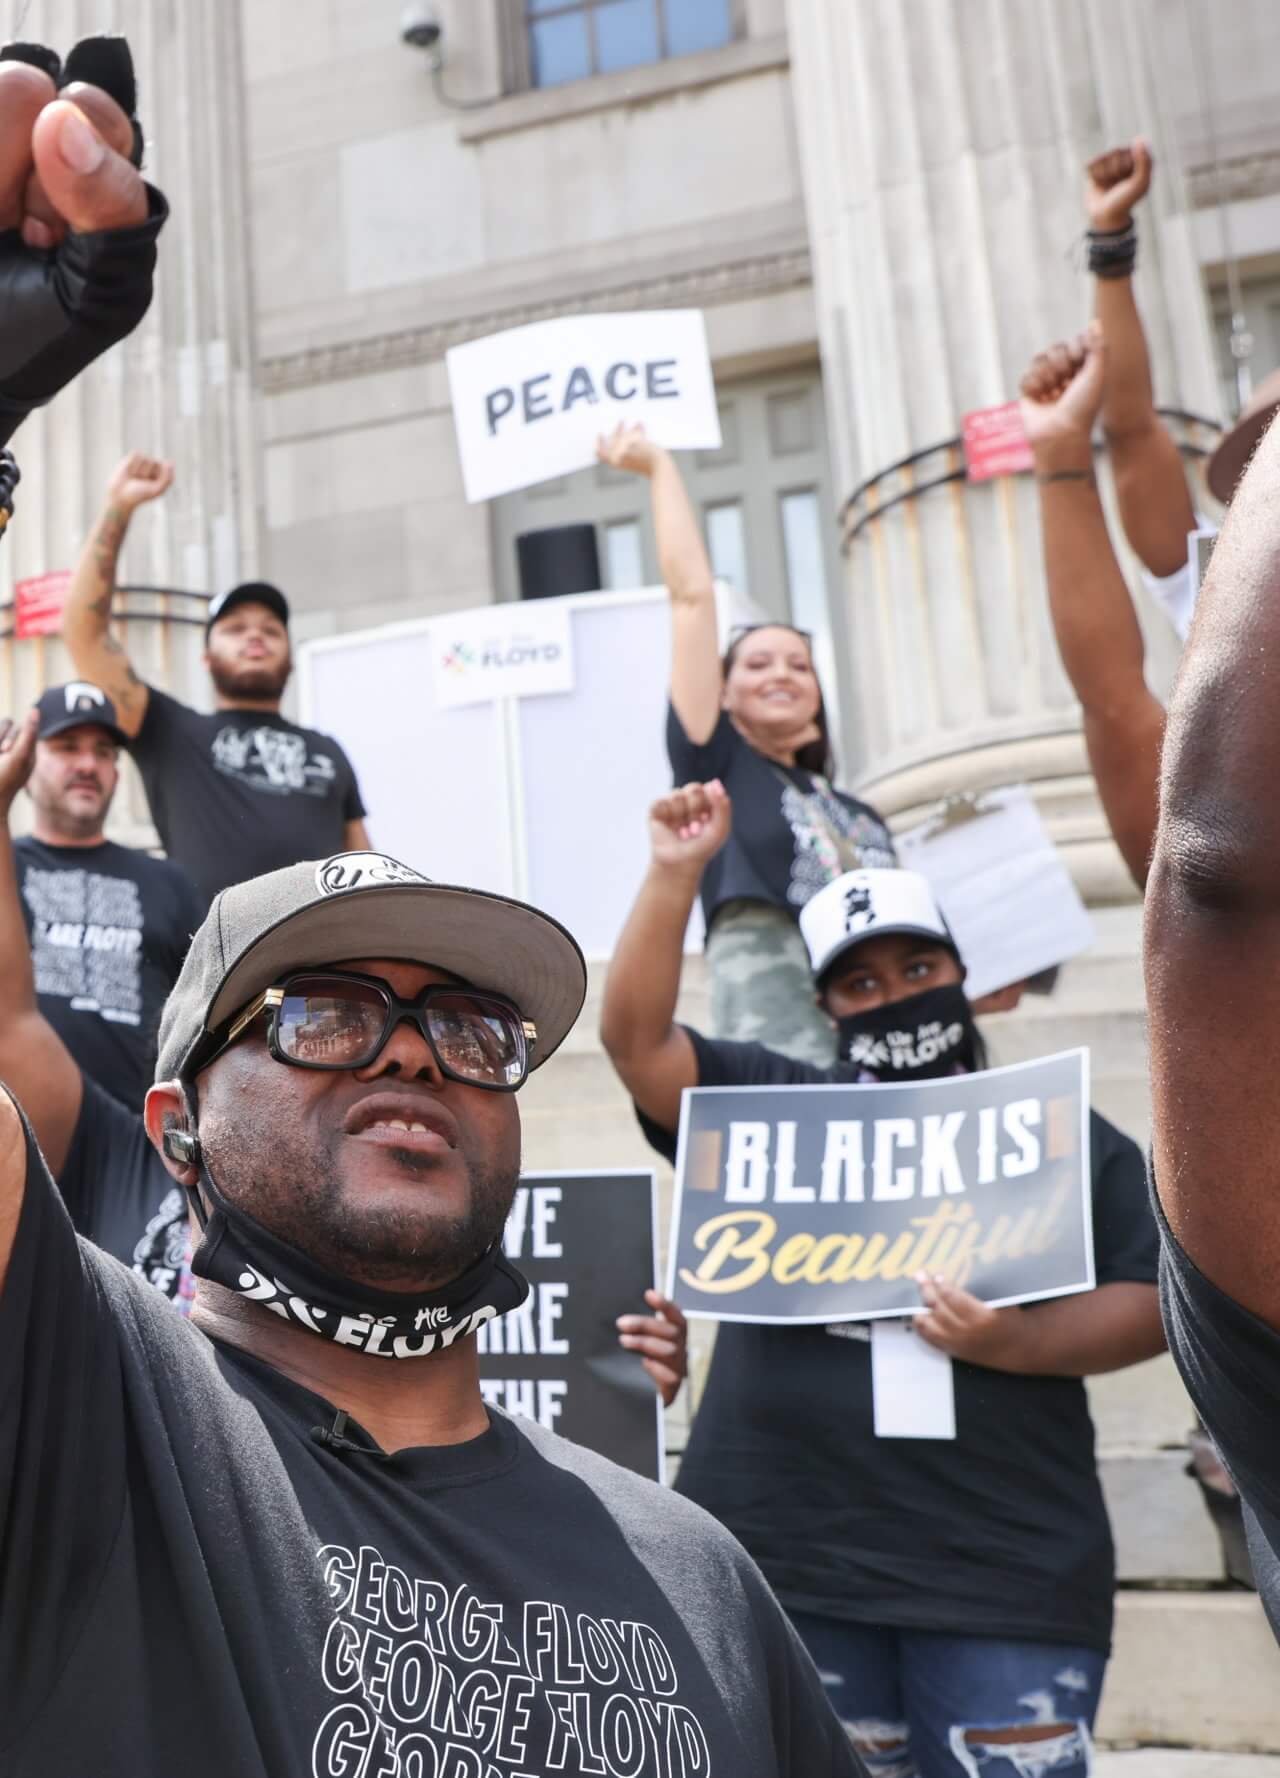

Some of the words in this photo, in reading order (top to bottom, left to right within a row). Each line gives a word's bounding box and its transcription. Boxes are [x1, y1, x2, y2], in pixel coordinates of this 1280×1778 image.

[485, 359, 681, 437] PEACE
[892, 1022, 963, 1069] FLOYD
[725, 1111, 966, 1204] BLACK
[977, 1098, 1042, 1185] IS
[678, 1166, 1073, 1294] Beautiful
[523, 1601, 678, 1696] FLOYD
[312, 1703, 540, 1778] GEOR
[321, 1617, 536, 1764] GEORGE
[545, 1693, 711, 1778] FLOYD
